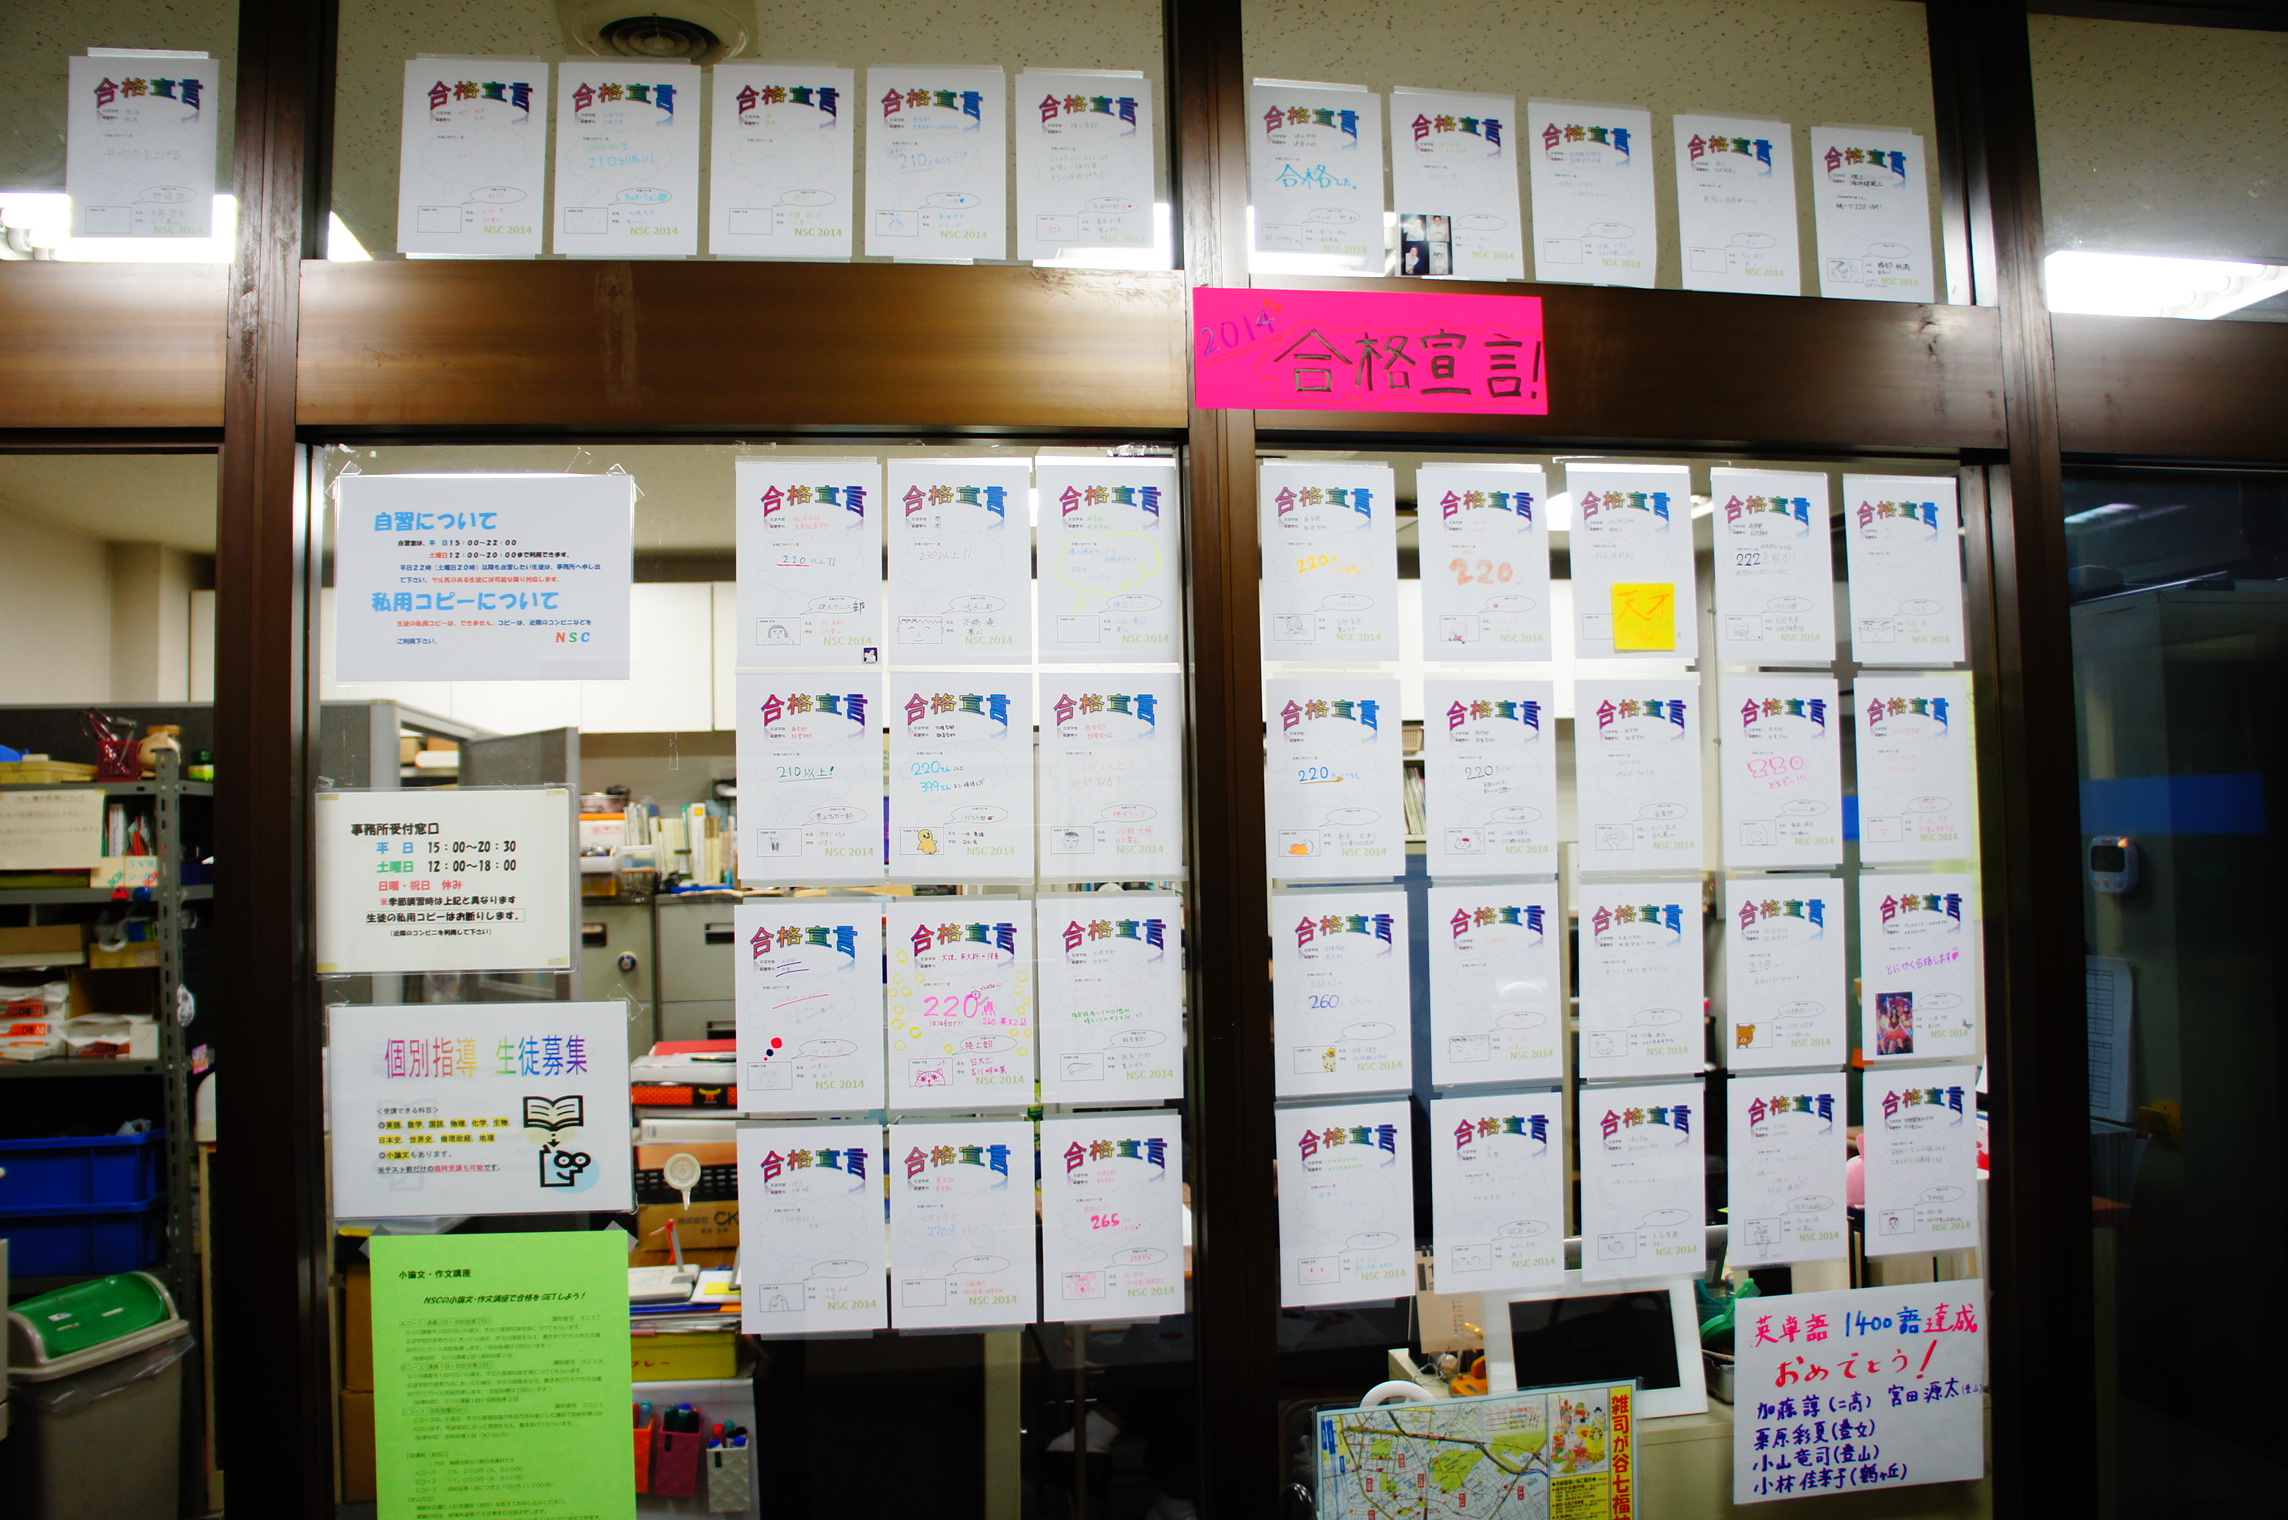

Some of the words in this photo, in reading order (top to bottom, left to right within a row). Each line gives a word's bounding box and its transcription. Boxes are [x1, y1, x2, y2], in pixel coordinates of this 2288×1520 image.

[94, 78, 203, 111] 合格宣言
[428, 81, 532, 113] 合格宣言
[572, 82, 676, 114] 合格宣言
[736, 86, 839, 118] 合格宣言
[882, 88, 982, 121] 合格宣言
[1040, 94, 1138, 126] 合格宣言
[1265, 106, 1359, 141] 合格宣言
[1412, 114, 1502, 148] 合格宣言
[1544, 124, 1631, 157] 合格宣言
[1690, 135, 1772, 169] 合格宣言
[900, 153, 927, 170] 210
[1276, 163, 1358, 190] 合格した。
[1825, 146, 1906, 178] 合格宣言
[485, 226, 506, 235] NSC
[509, 226, 533, 236] 2014
[941, 230, 961, 240] NSC
[964, 231, 987, 241] 2014
[1200, 310, 1275, 356] 2014
[1274, 328, 1542, 400] 合格宣言!
[761, 486, 867, 517] 合格宣言
[904, 486, 1007, 517] 合格宣言
[1060, 486, 1162, 517] 合格宣言
[1276, 488, 1373, 519] 合格宣言
[1441, 492, 1534, 521] 合格宣言
[1583, 492, 1670, 521] 合格宣言
[1726, 496, 1810, 526] 合格宣言
[1858, 502, 1938, 532] 合格宣言
[374, 511, 497, 532] 自習について
[783, 554, 806, 565] 210
[1296, 554, 1330, 573] 220
[1449, 557, 1514, 585] 220
[1736, 552, 1760, 566] 222
[371, 591, 559, 612] 私用コピーについて
[1616, 587, 1671, 622] 天才
[824, 636, 845, 646] NSC
[849, 636, 872, 646] 2014
[1501, 634, 1519, 643] NSC
[1522, 634, 1542, 643] 2014
[761, 694, 868, 726] 合格宣言
[905, 694, 1010, 726] 合格宣言
[1055, 694, 1158, 726] 合格宣言
[1282, 700, 1379, 732] 合格宣言
[1447, 700, 1541, 732] 合格宣言
[1597, 700, 1687, 729] 合格宣言
[1742, 698, 1826, 728] 合格宣言
[1868, 698, 1949, 728] 合格宣言
[776, 765, 836, 778] 210以上!
[1298, 766, 1329, 783] 220
[1465, 765, 1493, 780] 220
[351, 823, 440, 836] 事務所受付窓口
[1654, 840, 1671, 850] NSC
[1675, 840, 1694, 849] 2014
[1117, 844, 1137, 854] NSC
[1141, 844, 1163, 854] 2014
[377, 861, 414, 873] 土曜日
[379, 880, 431, 891] 日曜・祝日
[442, 880, 462, 890] 休み
[366, 911, 519, 923] 生徒の私用コピーはお断りします。
[1451, 906, 1545, 939] 合格宣言
[1594, 904, 1683, 935] 合格宣言
[1740, 900, 1825, 930] 合格宣言
[1881, 894, 1962, 924] 合格宣言
[750, 926, 858, 959] 合格宣言
[910, 922, 1017, 958] 合格宣言
[1063, 920, 1166, 953] 合格宣言
[1296, 914, 1394, 948] 合格宣言
[1887, 951, 1952, 976] とにかく合格します
[923, 994, 979, 1019] 220
[1308, 994, 1340, 1009] 260
[385, 1037, 478, 1079] 個別指導
[496, 1035, 588, 1076] 生徒募集
[965, 1041, 993, 1050] 陸上部
[1510, 1051, 1528, 1059] NSC
[1532, 1048, 1553, 1058] 2014
[1126, 1069, 1147, 1079] NSC
[1150, 1068, 1174, 1079] 2014
[1748, 1094, 1834, 1127] 合格宣言
[1882, 1086, 1964, 1119] 合格宣言
[1454, 1115, 1549, 1149] 合格宣言
[1602, 1106, 1690, 1140] 合格宣言
[1064, 1138, 1167, 1172] 合格宣言
[1299, 1124, 1398, 1161] 合格宣言
[760, 1148, 868, 1183] 合格宣言
[905, 1144, 1010, 1178] 合格宣言
[1090, 1213, 1121, 1230] 265
[399, 1269, 471, 1279] 小論文・作文講座
[1512, 1258, 1530, 1268] NSC
[1534, 1256, 1554, 1266] 2014
[1755, 1314, 1830, 1347] 英単語
[1845, 1303, 1978, 1337] 1400語達成
[1775, 1339, 1937, 1388] おめでとう！
